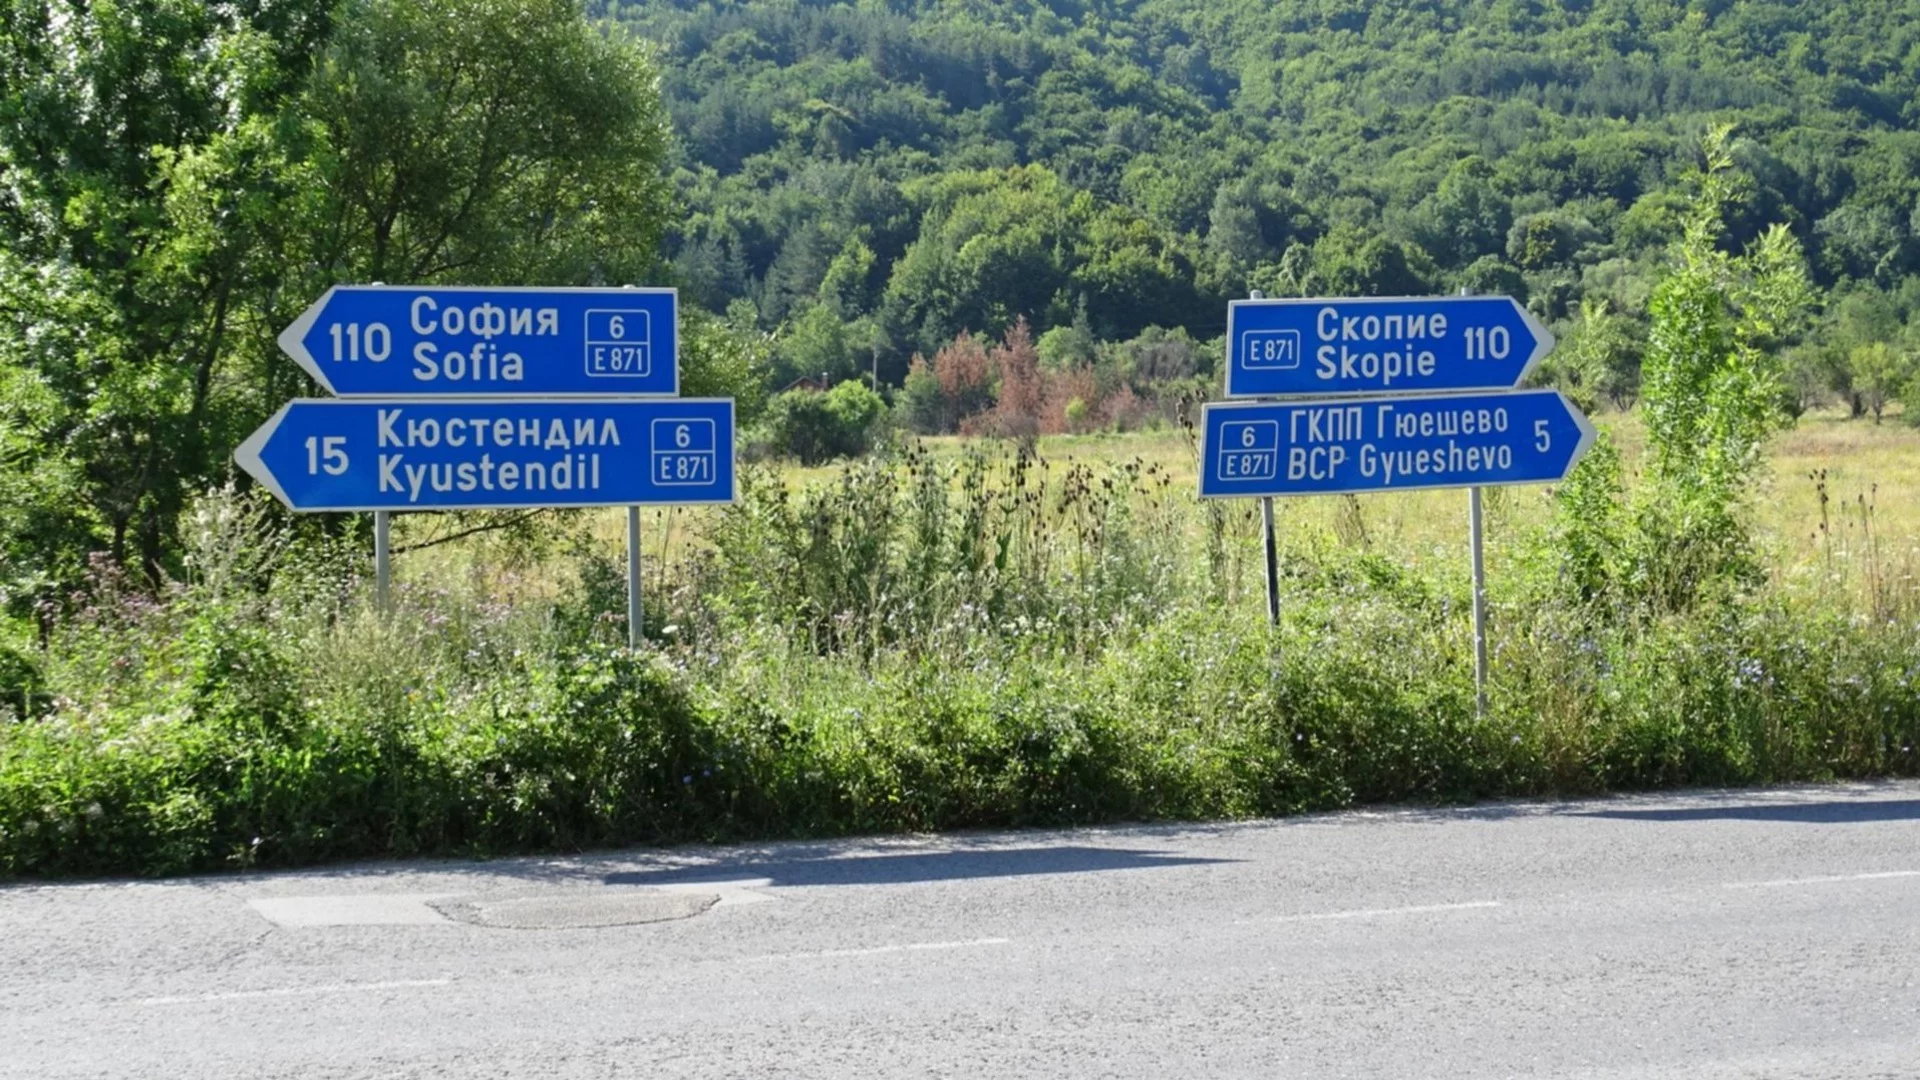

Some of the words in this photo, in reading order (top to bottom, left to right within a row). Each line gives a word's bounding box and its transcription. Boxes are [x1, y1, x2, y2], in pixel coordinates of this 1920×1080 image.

[411, 295, 559, 340] София
[610, 315, 625, 339] 6
[1316, 306, 1448, 342] Скопие
[329, 322, 392, 362] 110
[412, 342, 525, 381] Sofia
[1463, 325, 1510, 360] 110
[1315, 344, 1436, 386] Skopie
[377, 408, 621, 450] Кюстендил
[675, 424, 690, 448] 6
[1242, 426, 1256, 448] 6
[1290, 407, 1363, 444] ГКПП
[1377, 404, 1509, 439] Гюешево
[1534, 419, 1551, 453] 5
[305, 436, 349, 476] 15
[1287, 445, 1346, 481] BCP
[1359, 439, 1512, 485] Gyueshevo
[378, 453, 601, 502] Kyustendil
